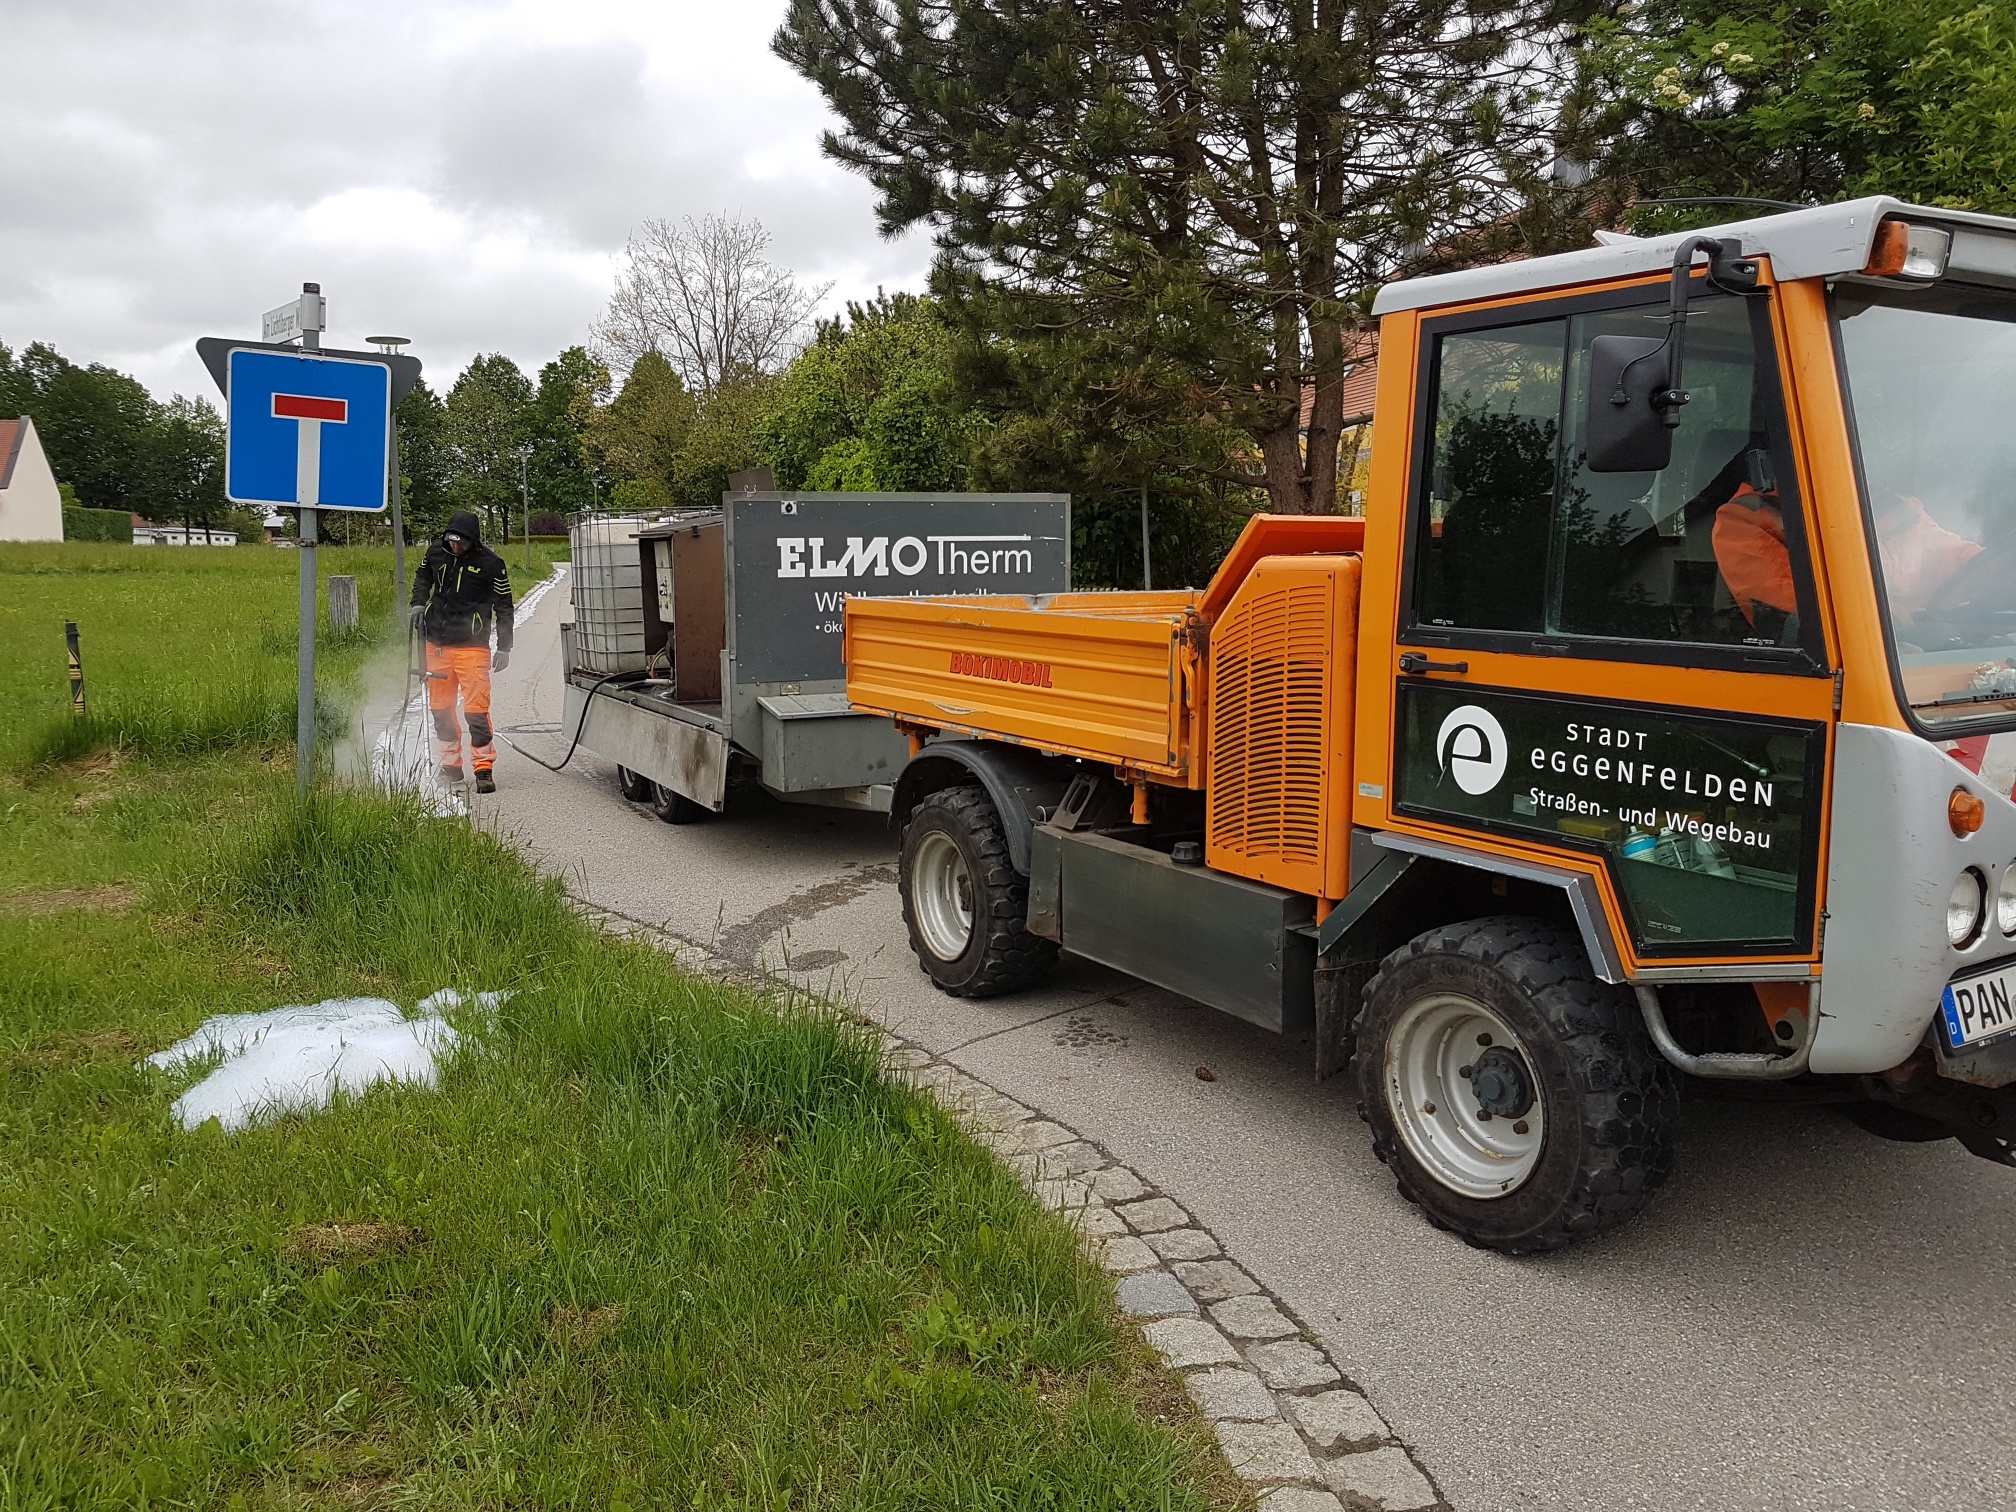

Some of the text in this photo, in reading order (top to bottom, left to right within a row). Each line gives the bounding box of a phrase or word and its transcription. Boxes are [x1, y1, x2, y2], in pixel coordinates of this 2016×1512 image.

[950, 651, 1053, 688] BOKIMOBIL
[1529, 787, 1771, 849] Straßen- und Wegebau
[1949, 1021, 1957, 1035] D
[1955, 977, 2013, 1035] PAN
